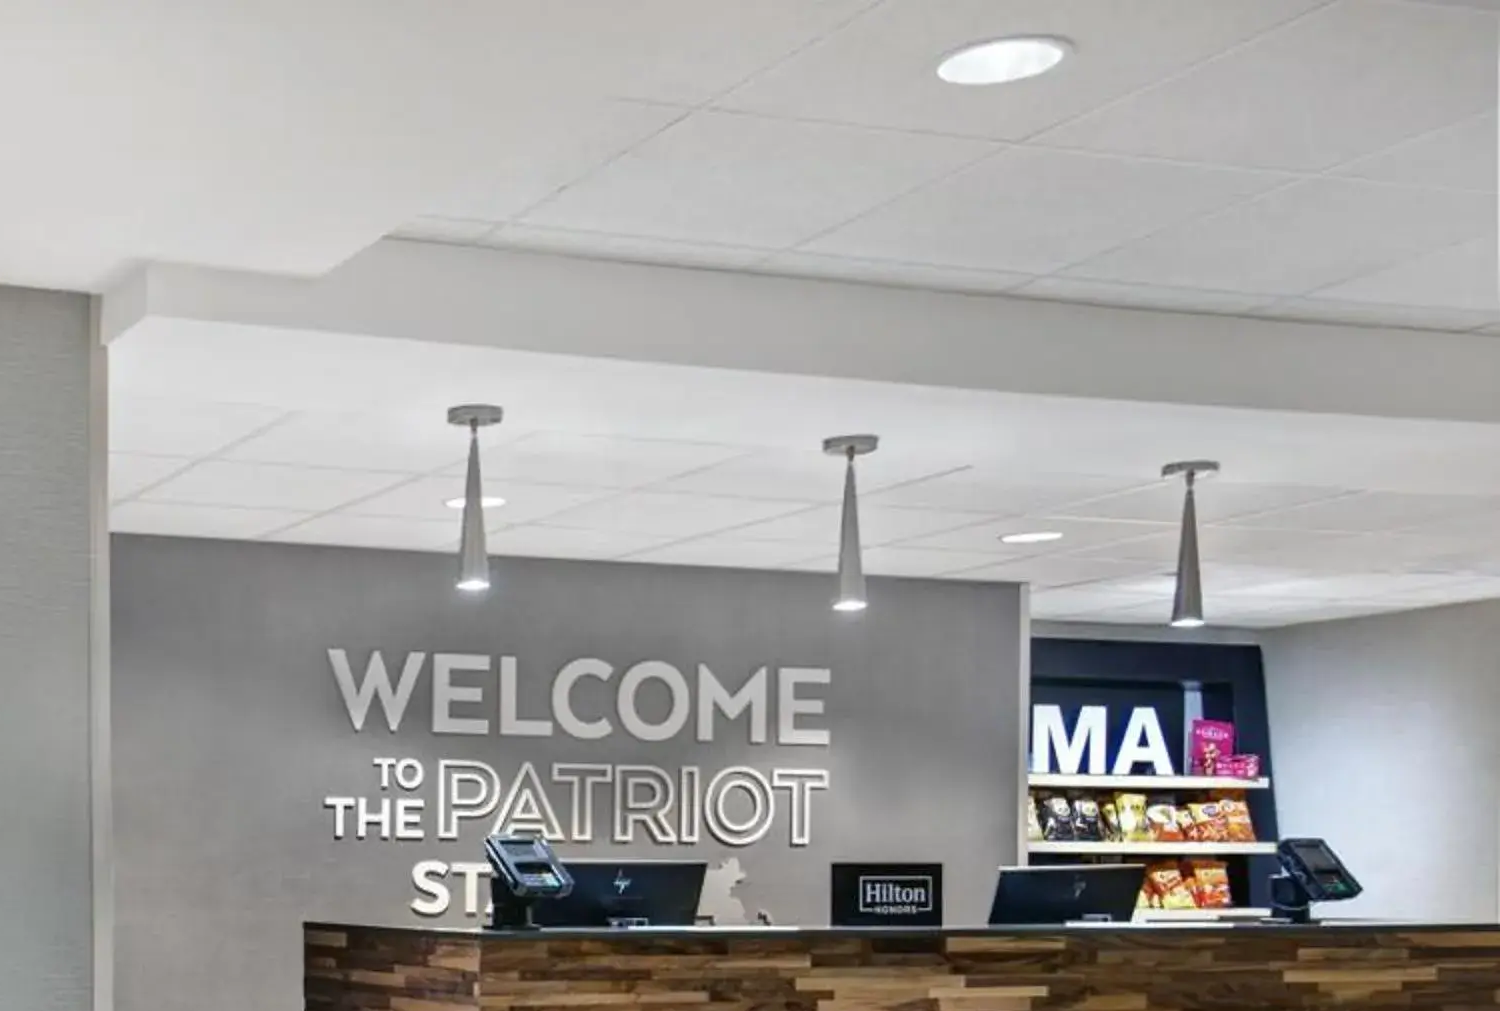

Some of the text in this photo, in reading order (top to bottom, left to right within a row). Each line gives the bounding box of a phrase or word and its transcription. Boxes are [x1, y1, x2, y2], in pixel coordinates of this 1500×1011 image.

[327, 648, 832, 745] WELCOME
[1032, 703, 1175, 775] MA
[324, 759, 829, 846] THE PATRIOT
[373, 757, 425, 790] TO
[410, 859, 494, 917] ST
[865, 883, 927, 903] Hilton
